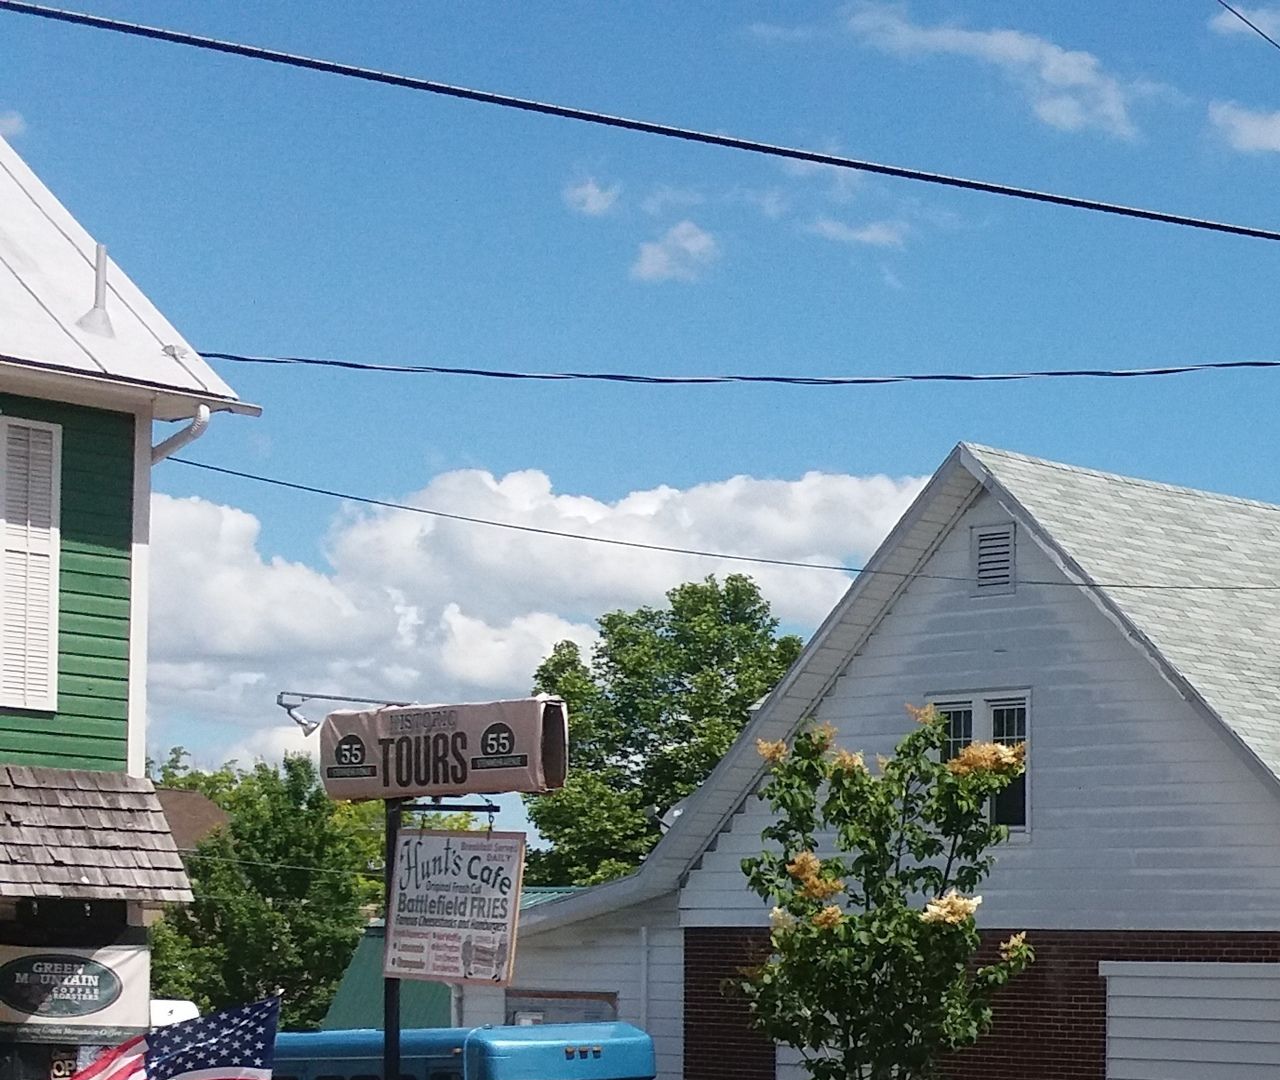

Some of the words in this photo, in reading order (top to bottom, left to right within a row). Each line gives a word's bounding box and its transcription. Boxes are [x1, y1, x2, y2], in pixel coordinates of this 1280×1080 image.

[341, 743, 361, 764] 55
[487, 733, 510, 754] 55
[378, 731, 468, 788] TOURS
[400, 838, 463, 890] Hunt's
[467, 855, 511, 895] Cafe
[397, 892, 467, 917] Battlefield
[469, 897, 508, 919] FRIES
[32, 962, 85, 975] GREEN
[53, 1060, 76, 1077] OP
